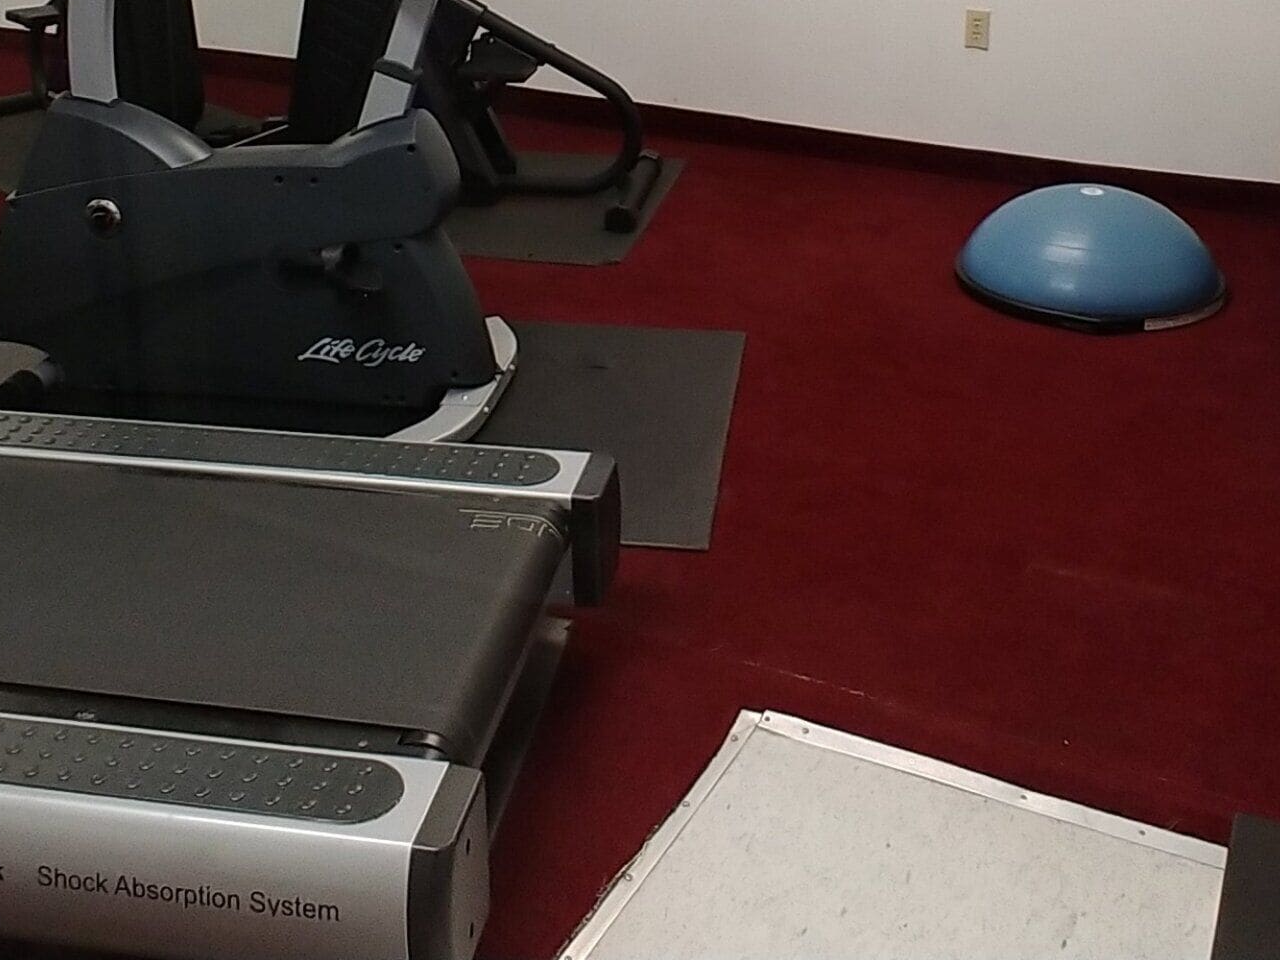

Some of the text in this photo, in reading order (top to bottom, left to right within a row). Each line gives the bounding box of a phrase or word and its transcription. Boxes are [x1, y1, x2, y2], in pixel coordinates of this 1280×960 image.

[297, 337, 426, 367] Life Cycle
[37, 864, 109, 895] Shock
[114, 874, 241, 911] Absorption
[250, 890, 341, 923] System
